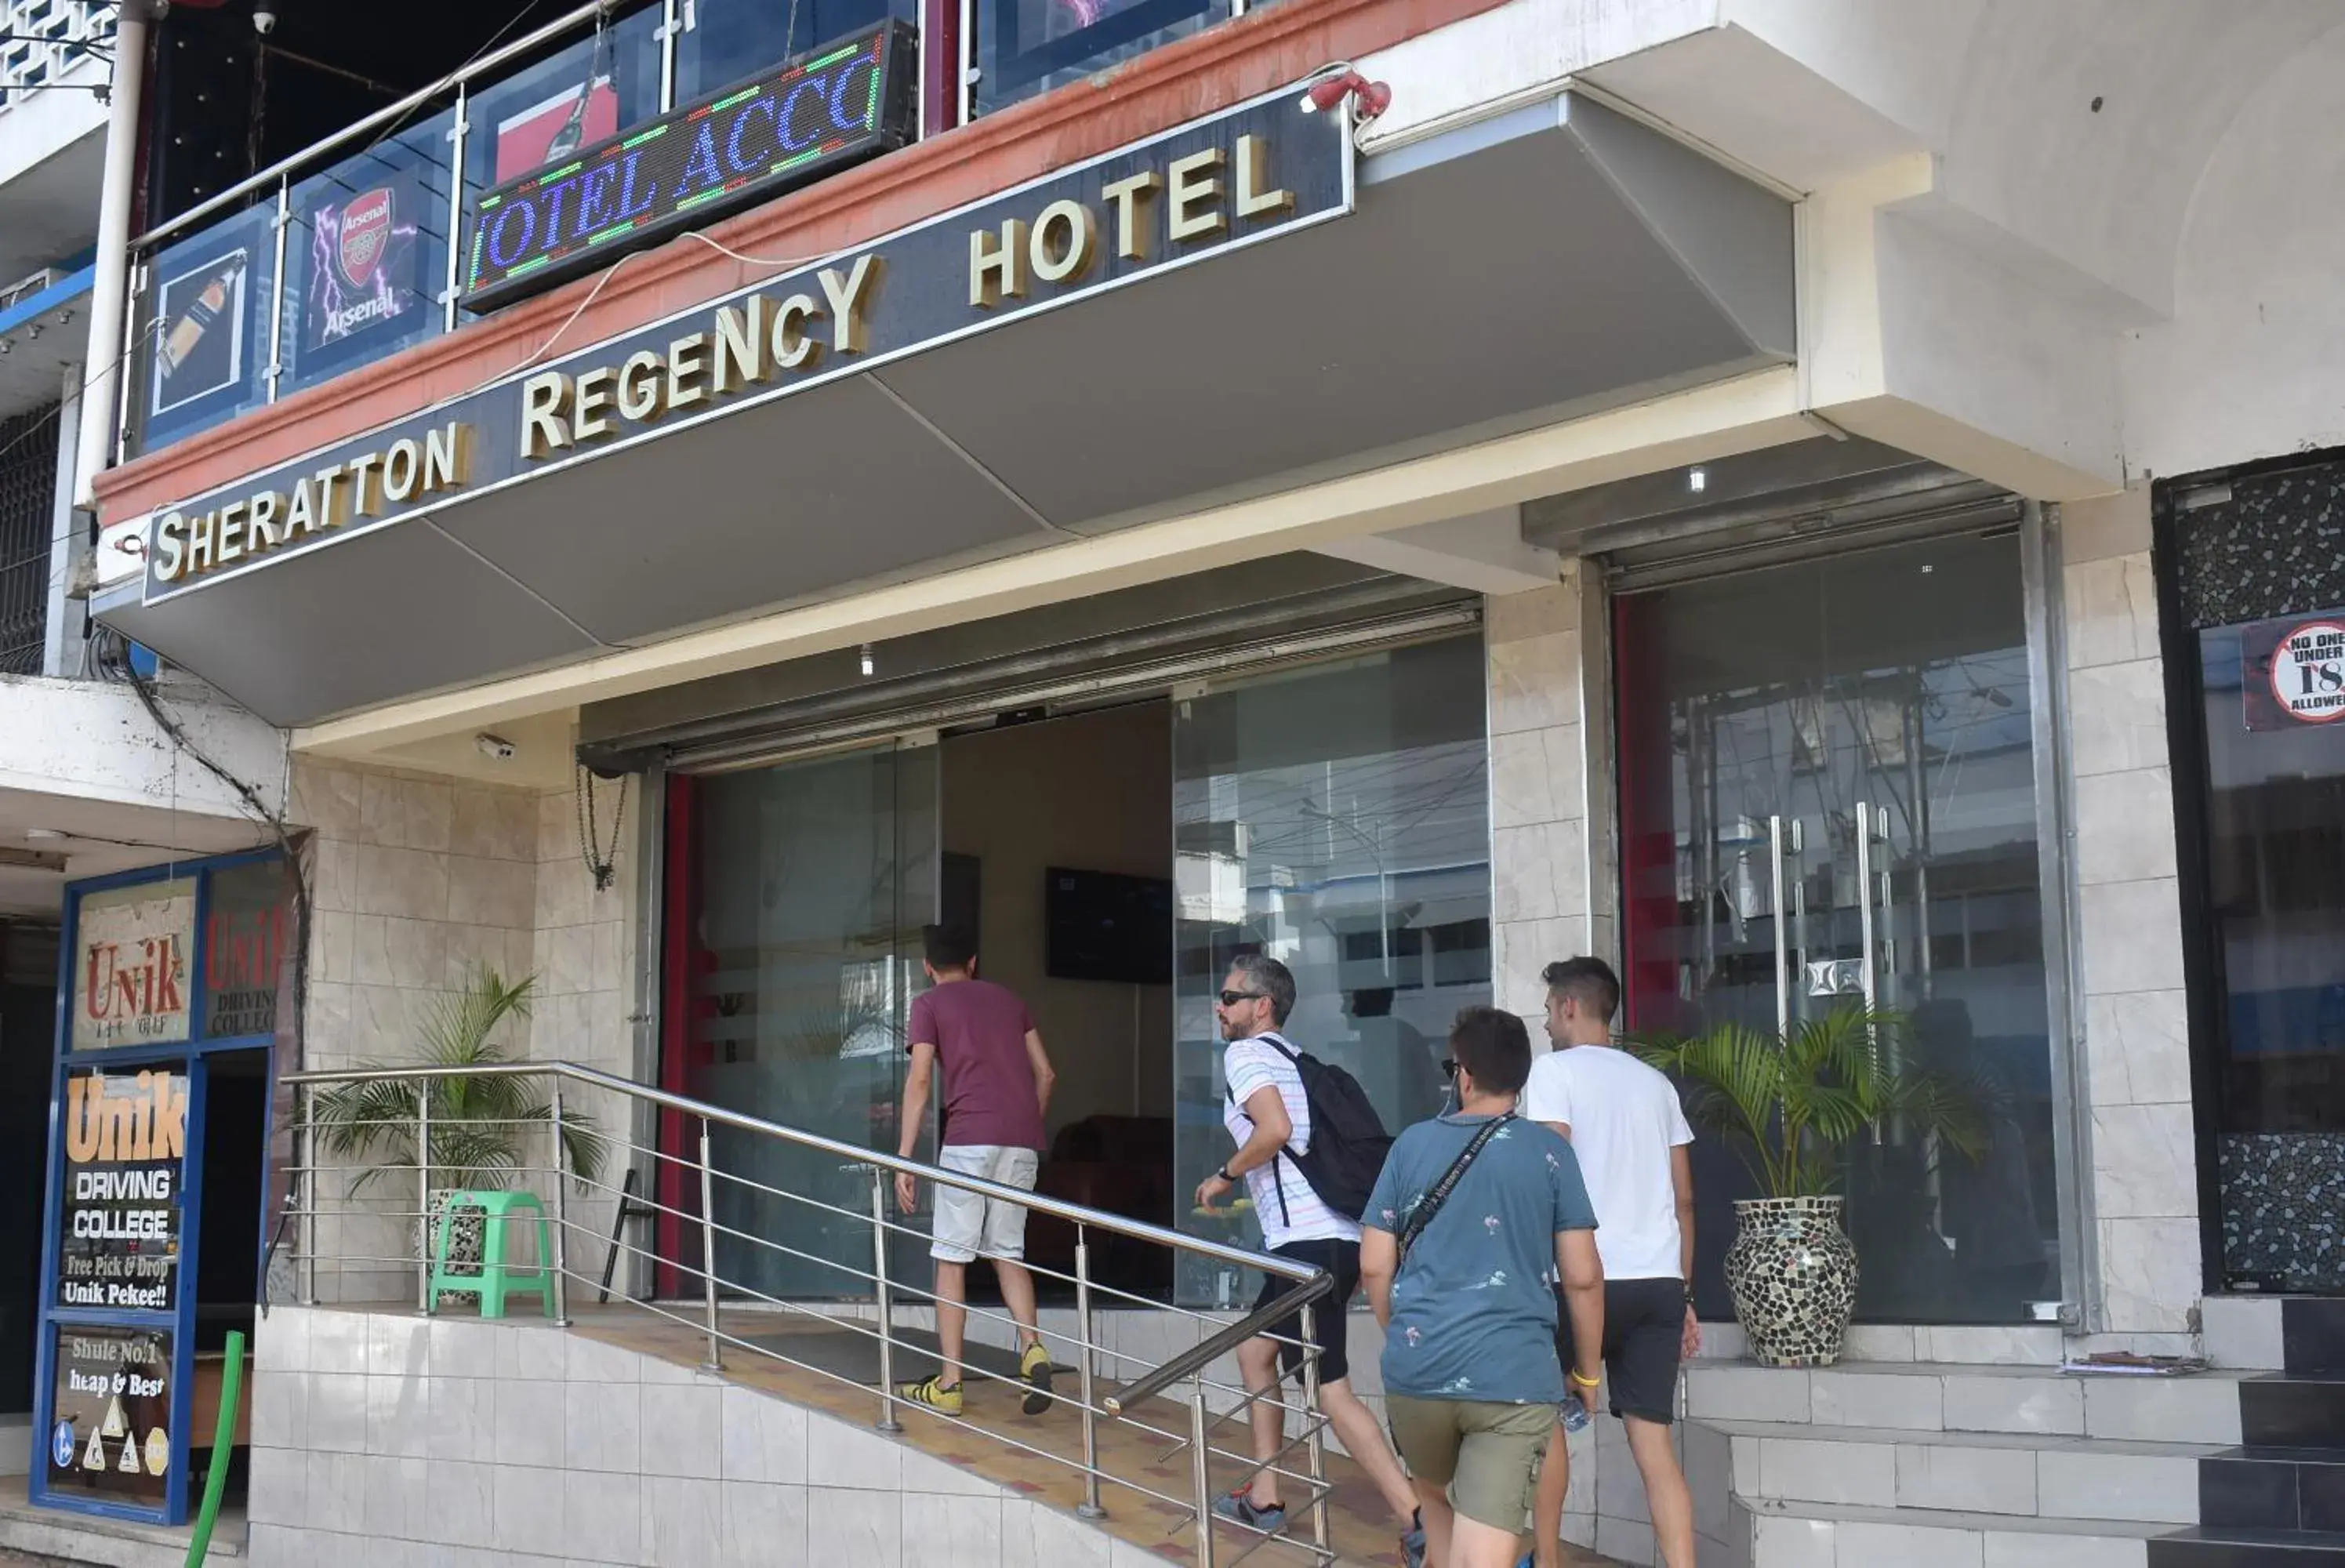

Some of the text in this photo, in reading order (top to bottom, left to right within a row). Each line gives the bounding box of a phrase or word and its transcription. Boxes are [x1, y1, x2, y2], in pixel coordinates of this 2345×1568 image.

[343, 201, 388, 232] Arsenal
[325, 287, 394, 332] Arsenal
[154, 133, 1290, 583] SHERATTON REGENCY HOTEL
[2291, 633, 2345, 650] NO ONE
[2294, 646, 2343, 663] UNDER
[2296, 662, 2343, 694] 18
[2291, 695, 2345, 710] ALLOWE
[67, 1069, 186, 1163] Unik
[76, 1170, 169, 1200] DRIVING
[74, 1210, 168, 1239] COLLEGE
[67, 1254, 168, 1283] Free Pick & Drop
[65, 1281, 167, 1307] Unik Pekee!!
[72, 1338, 117, 1361] Shule
[112, 1373, 126, 1393] &
[129, 1374, 165, 1396] Best
